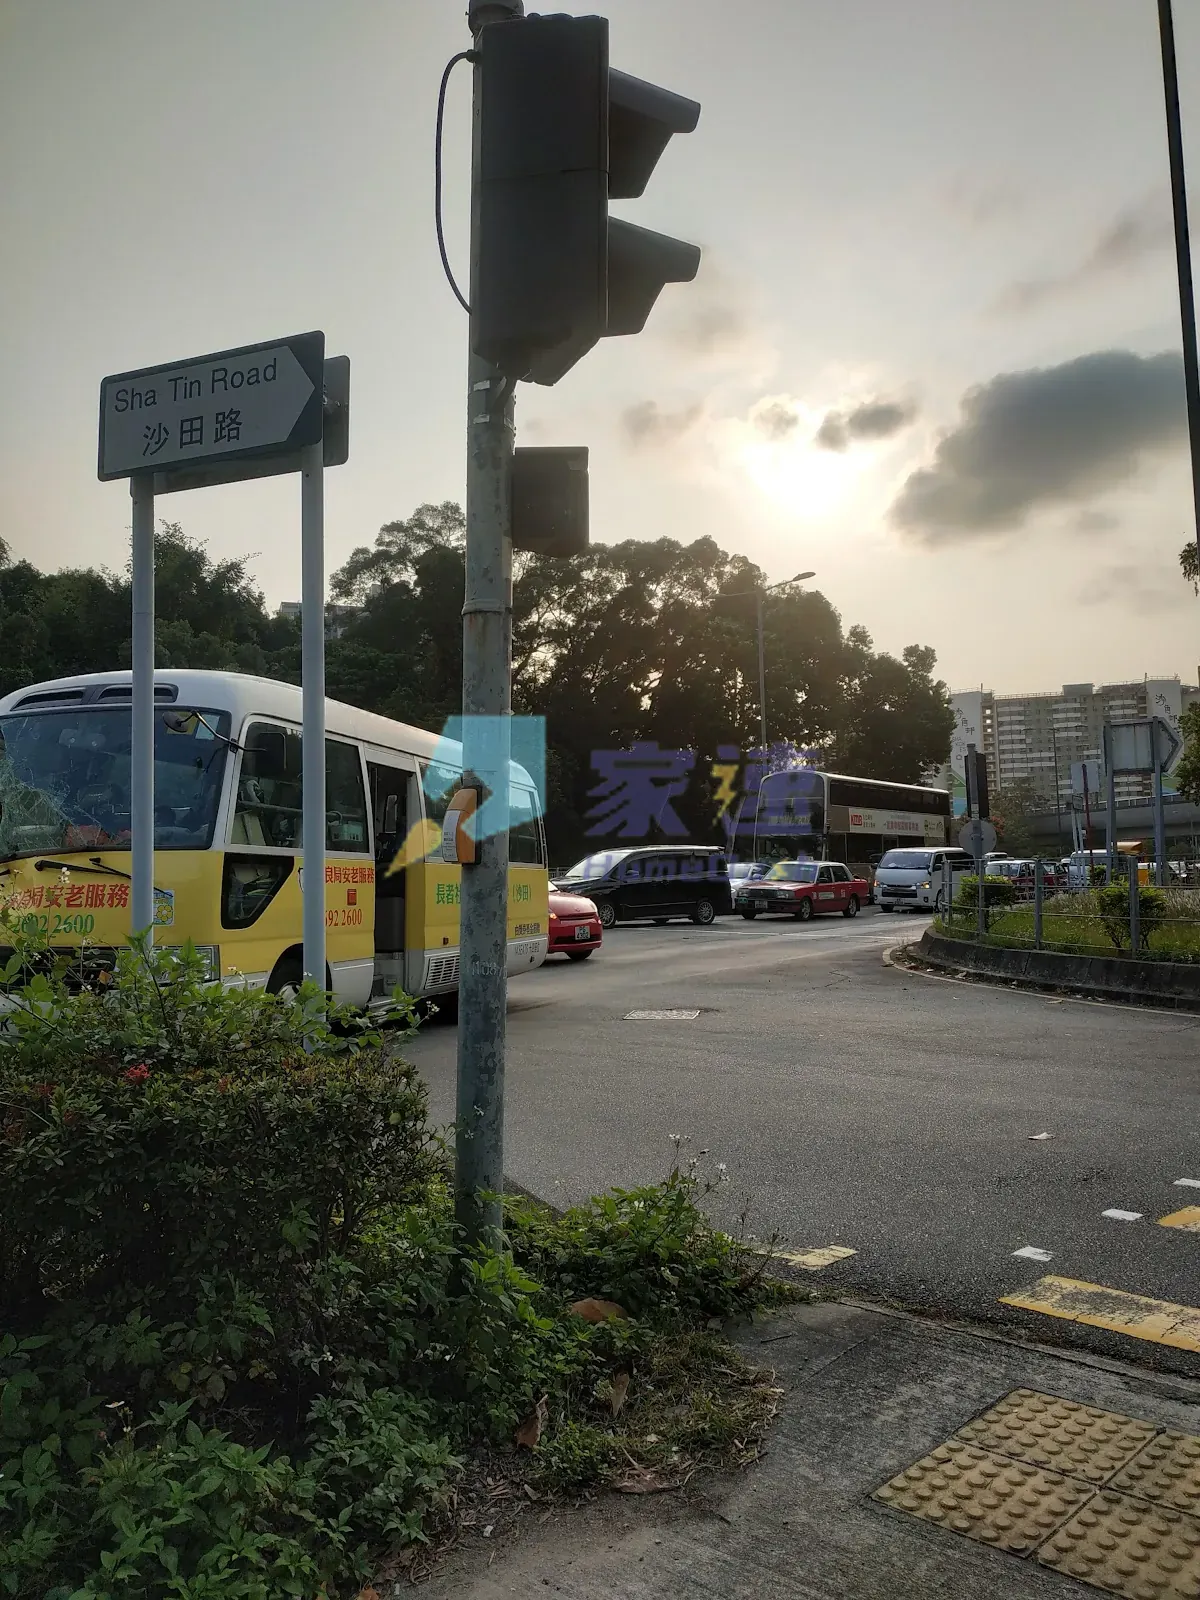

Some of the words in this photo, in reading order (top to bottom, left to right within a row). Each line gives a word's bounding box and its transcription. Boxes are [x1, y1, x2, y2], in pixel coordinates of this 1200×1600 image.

[114, 388, 157, 413] Sha
[168, 376, 202, 402] Tin
[211, 357, 278, 394] Road
[141, 407, 243, 457] 沙田路
[52, 913, 94, 934] 2600
[325, 909, 339, 927] 92
[341, 908, 362, 926] 2600
